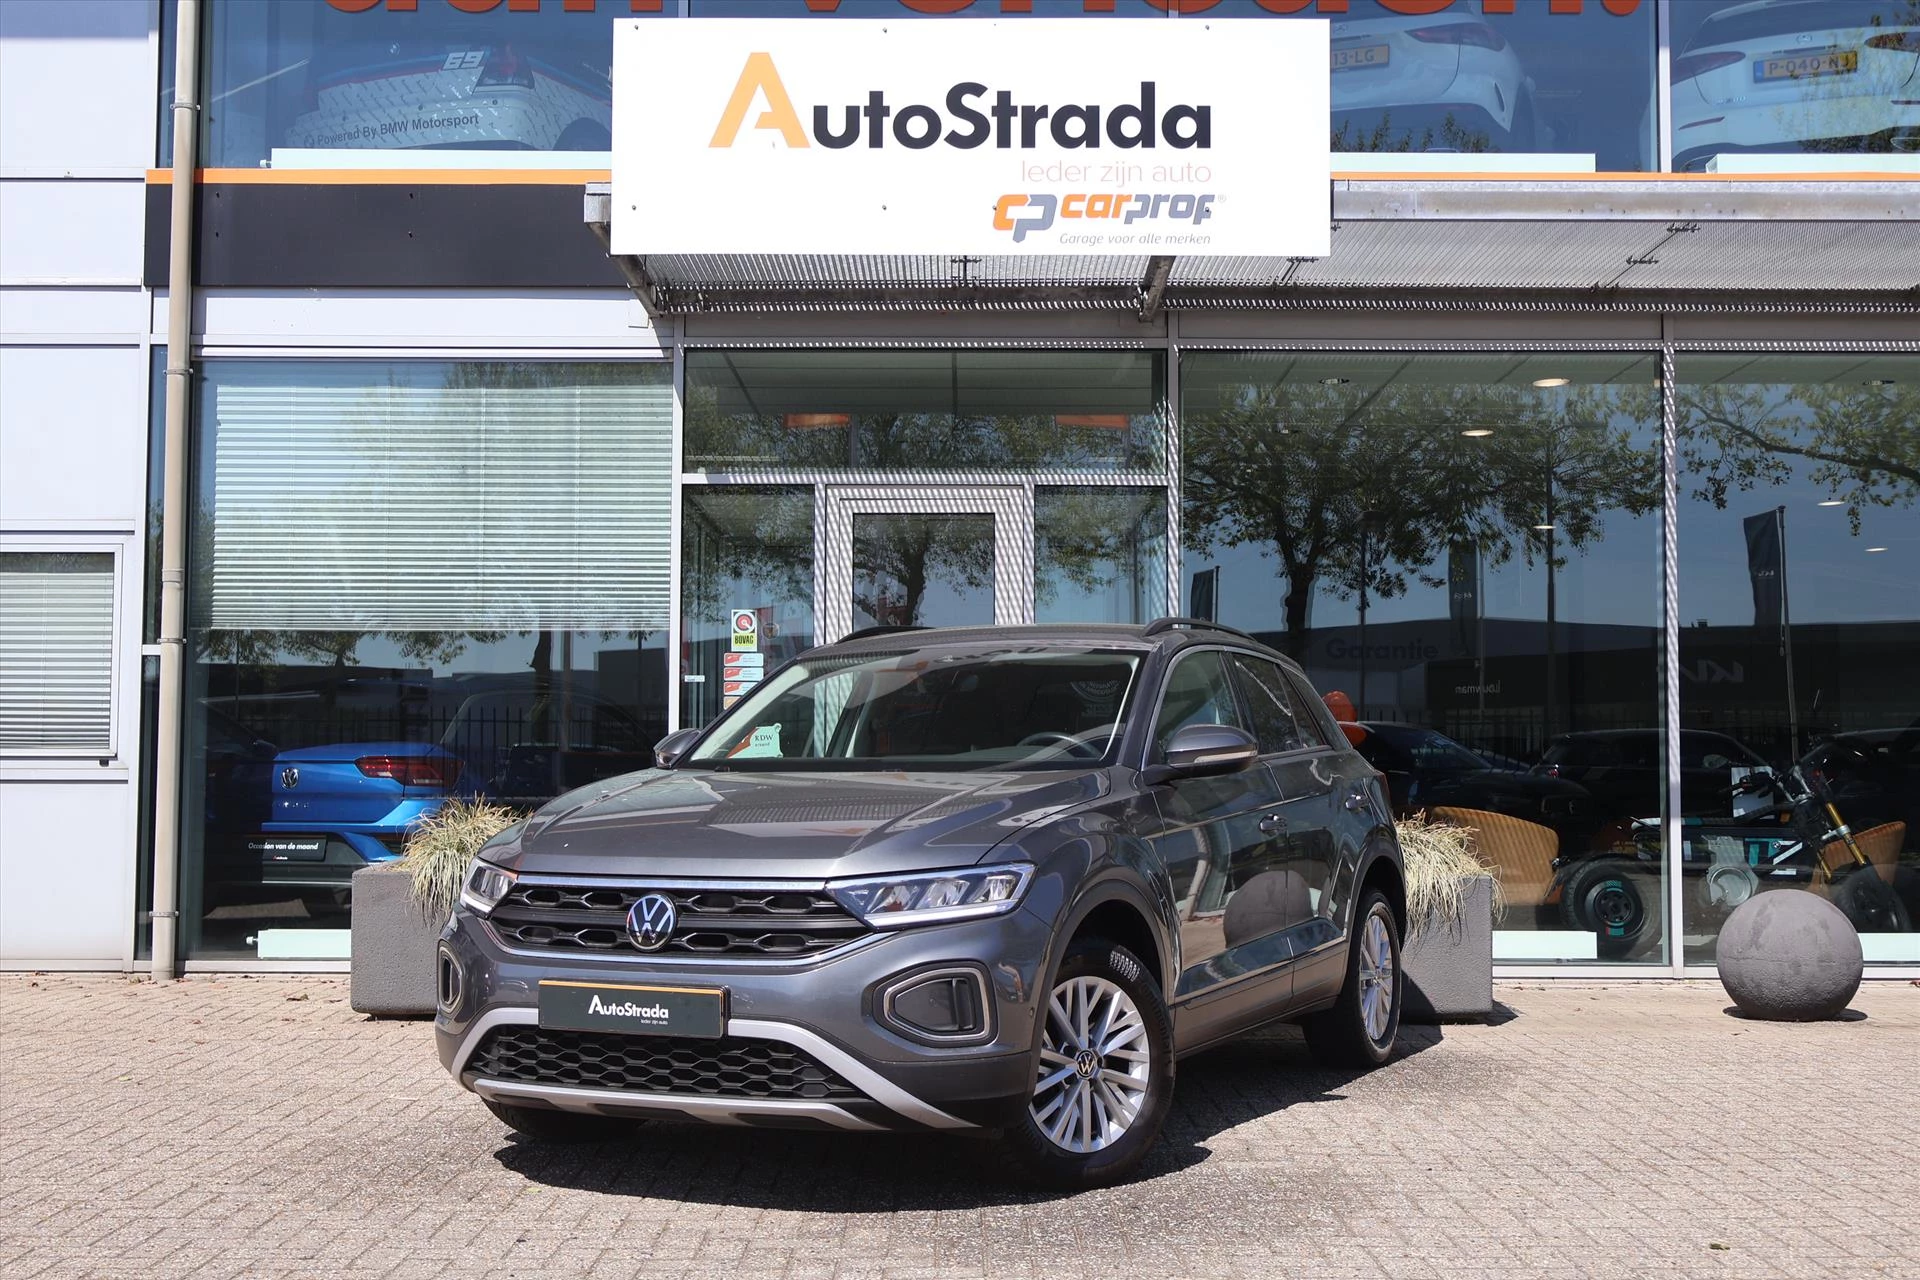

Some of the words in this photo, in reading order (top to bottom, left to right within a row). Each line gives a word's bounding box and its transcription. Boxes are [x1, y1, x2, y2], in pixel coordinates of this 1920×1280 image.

[443, 51, 485, 70] 69
[708, 51, 1212, 149] AutoStrada
[317, 126, 360, 146] Powered
[363, 126, 376, 140] By
[380, 121, 409, 136] BMW
[412, 113, 480, 130] Motorsport
[1021, 160, 1091, 183] Ieder
[1100, 161, 1143, 188] zijn
[1152, 164, 1212, 183] auto
[1060, 193, 1216, 225] carprof
[1060, 233, 1104, 247] Garage
[1108, 235, 1136, 244] voor
[1139, 233, 1162, 244] alle
[1165, 232, 1211, 244] merken
[734, 634, 754, 645] BOVAG
[1325, 637, 1439, 660] Garantie
[288, 842, 296, 850] de
[296, 842, 319, 850] maand
[588, 994, 669, 1019] AutoStrada
